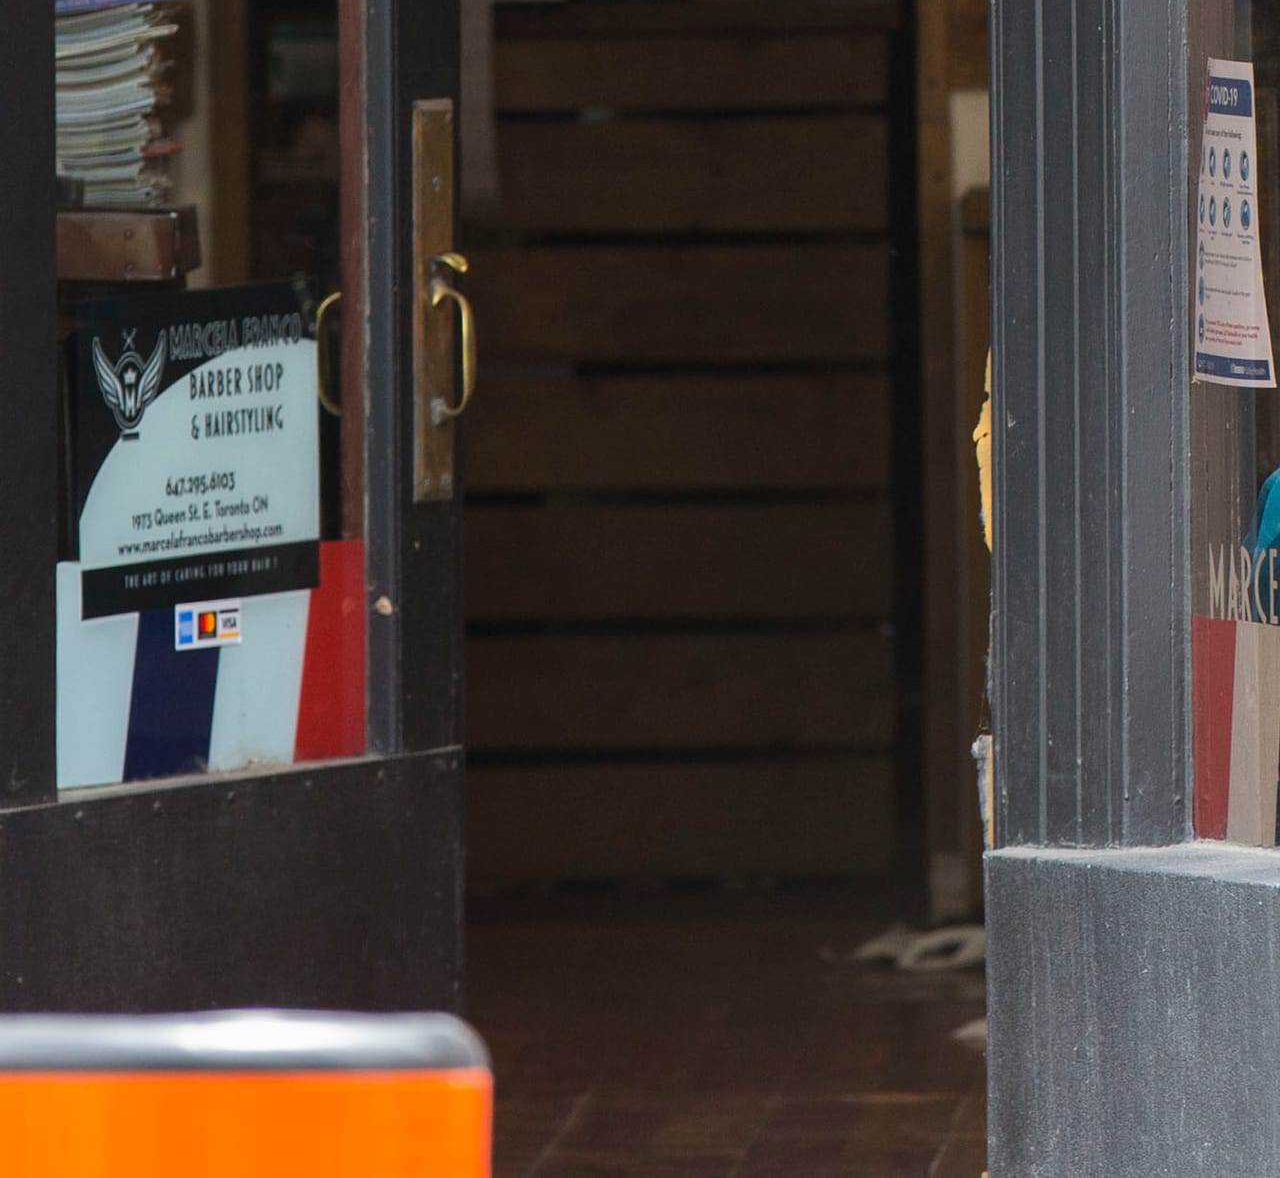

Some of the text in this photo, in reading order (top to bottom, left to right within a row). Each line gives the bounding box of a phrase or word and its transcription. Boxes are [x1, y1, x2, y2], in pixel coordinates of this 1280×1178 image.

[1210, 84, 1239, 108] COVID-19
[169, 312, 302, 362] MARCELA FRANCO
[189, 362, 284, 401] BARBER SHOP
[191, 405, 284, 440] & HAIRSTYLING
[165, 471, 236, 498] 647.295.6103
[132, 494, 269, 531] 1973 Queen St. E. Toronto ON
[118, 523, 284, 557] www.marcelafrancobarbershop.com
[124, 574, 140, 589] THE
[142, 572, 158, 587] ART
[160, 570, 172, 584] OF
[174, 566, 204, 582] CARING
[207, 563, 224, 579] FOR
[227, 560, 249, 577] YOUR
[221, 616, 237, 630] VISA
